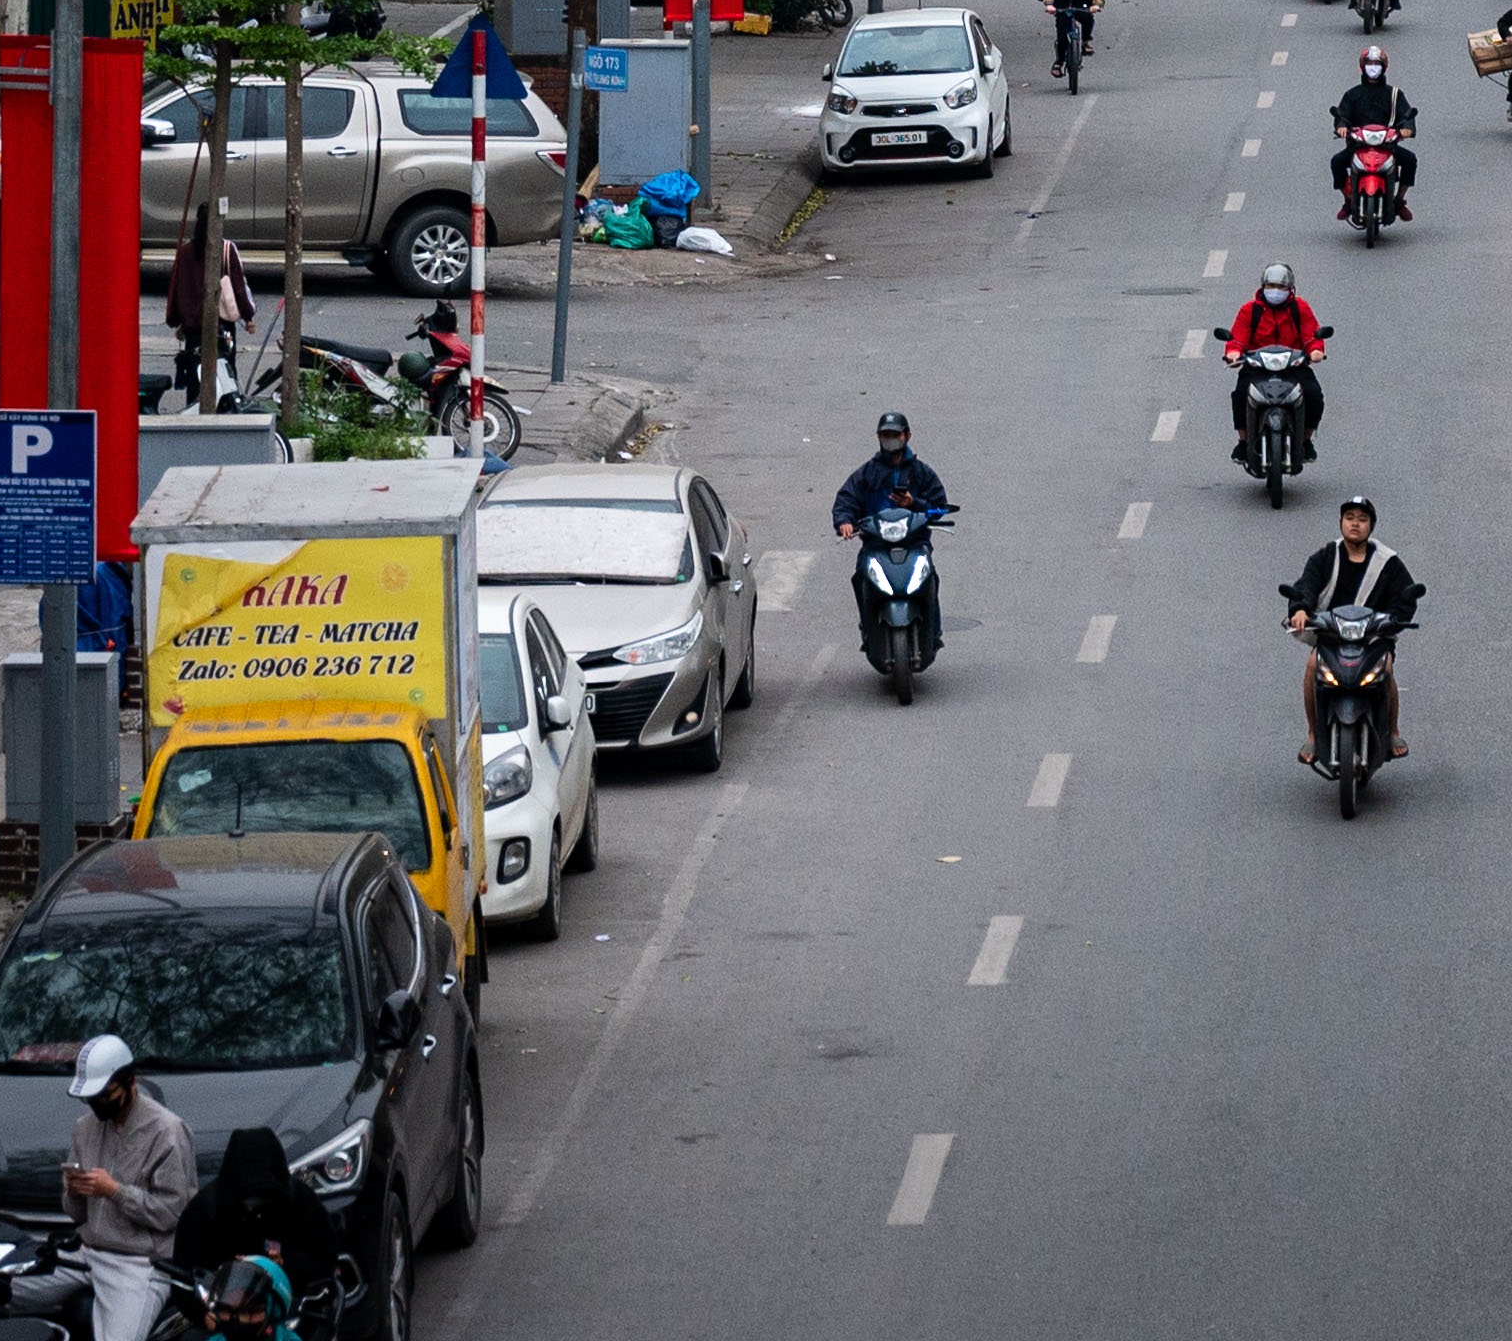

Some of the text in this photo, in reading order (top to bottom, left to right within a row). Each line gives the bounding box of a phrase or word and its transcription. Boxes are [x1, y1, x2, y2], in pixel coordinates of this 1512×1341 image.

[605, 57, 620, 70] 173
[11, 425, 53, 473] P
[173, 626, 233, 648] CAFE
[254, 624, 300, 645] TEA
[319, 621, 419, 644] MATCHA
[177, 654, 415, 682] Zalo: 0906 236 712
